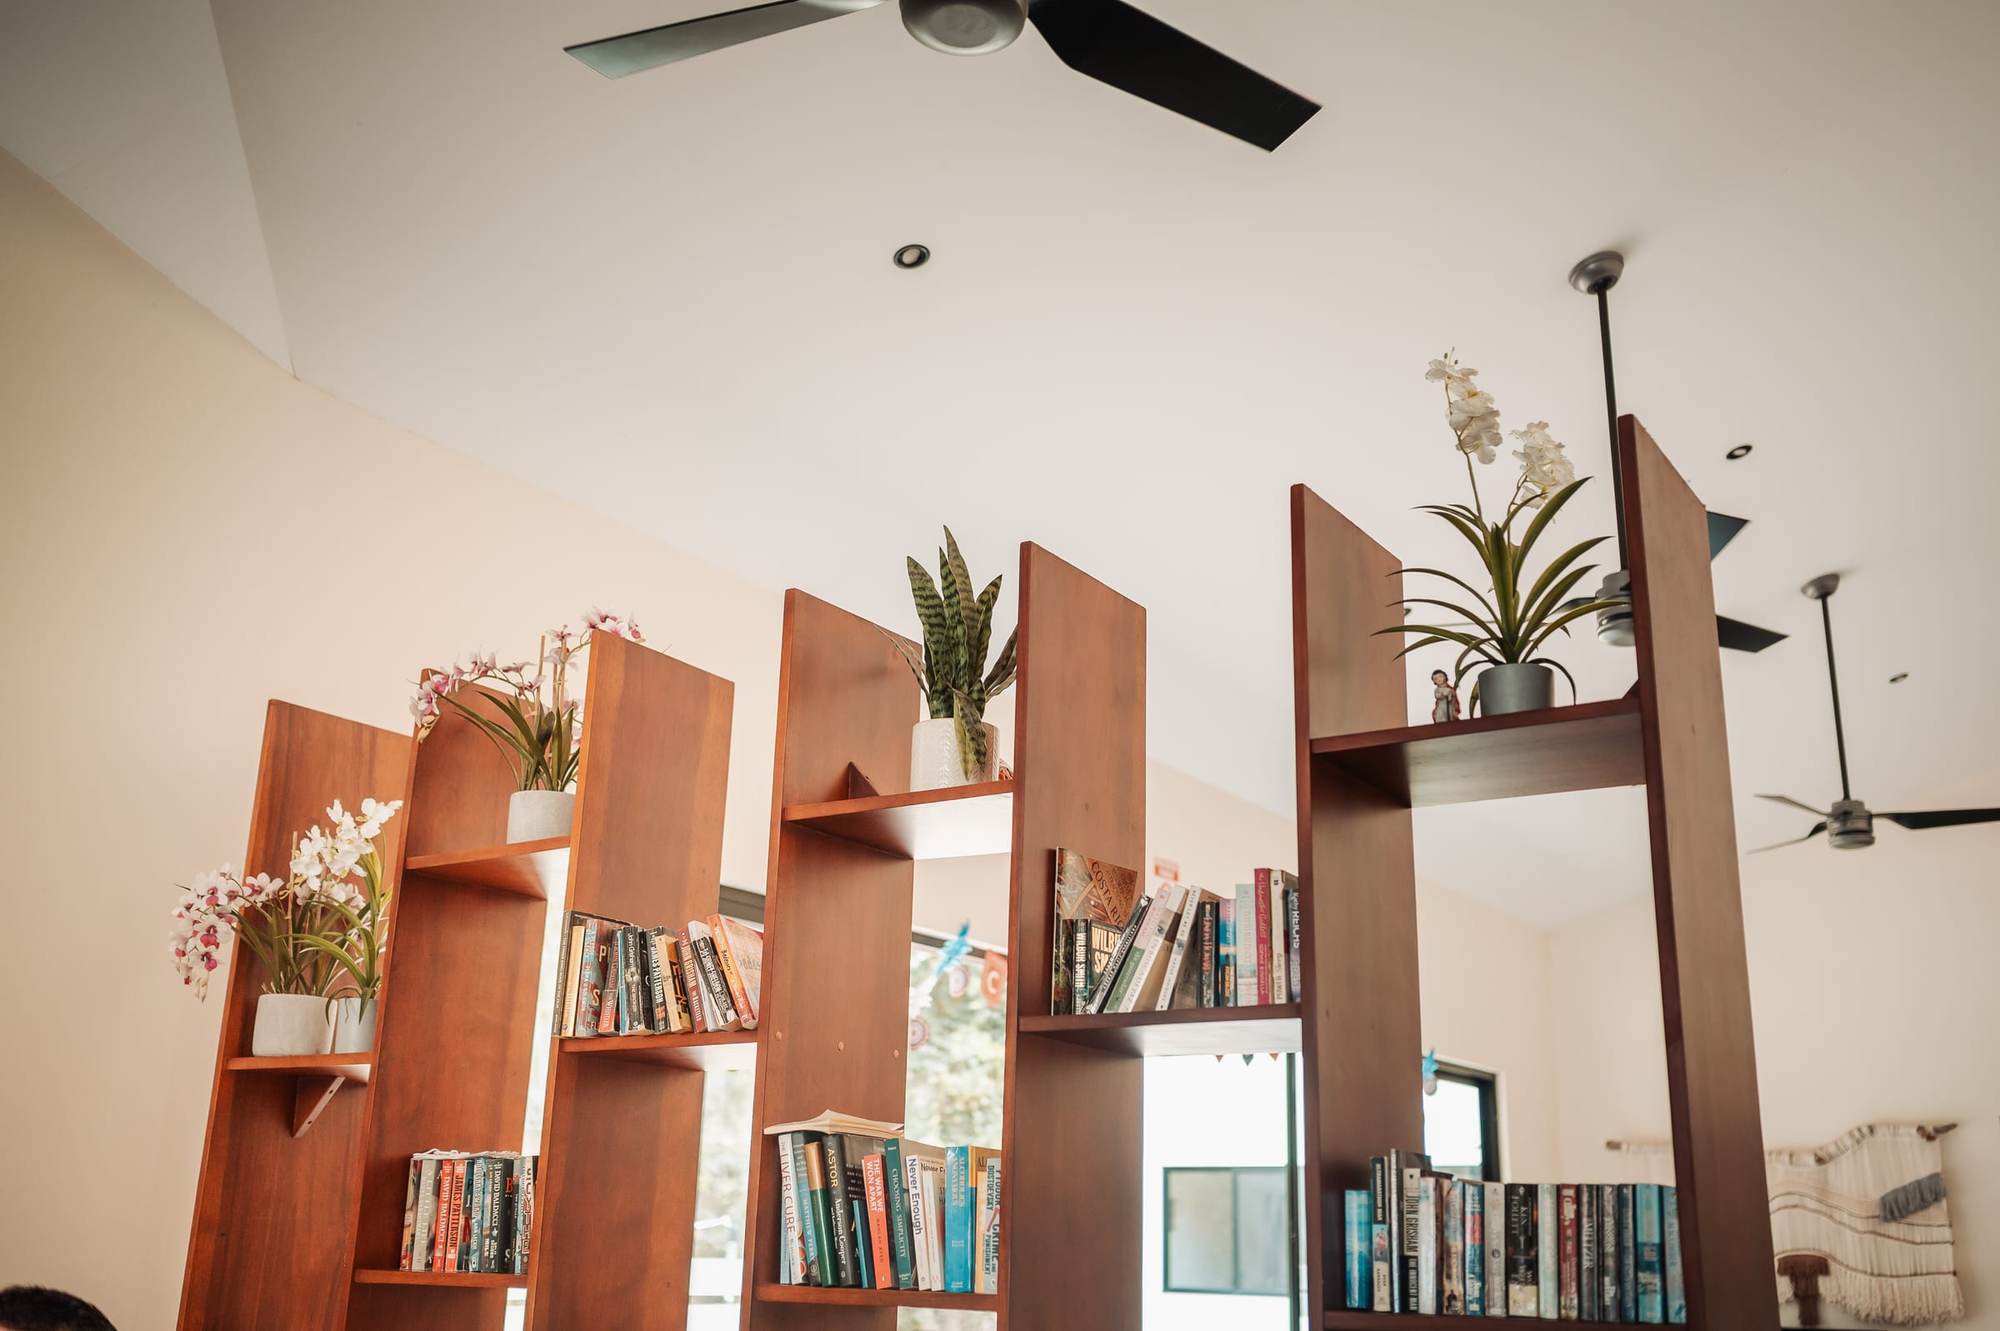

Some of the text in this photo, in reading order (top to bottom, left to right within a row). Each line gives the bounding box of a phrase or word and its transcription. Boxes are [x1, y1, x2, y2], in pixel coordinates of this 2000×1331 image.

[1091, 861, 1114, 906] COSTA
[1076, 932, 1086, 962] WILBUR
[1092, 926, 1121, 954] WILB
[652, 967, 664, 1004] PATTERSON
[1075, 964, 1086, 987] SMITH
[780, 1153, 791, 1192] LIVER
[827, 1148, 838, 1188] ASTOR
[866, 1161, 878, 1212] WON APART
[873, 1159, 881, 1176] THE
[877, 1199, 884, 1213] WE
[986, 1165, 994, 1211] DOSTOEVSKY
[449, 1176, 463, 1248] JAMES PATTERSON
[492, 1170, 501, 1227] DAVID BALDACCI
[783, 1193, 796, 1234] CURE
[891, 1168, 907, 1258] CHOOSING SIMPLICITY
[908, 1158, 923, 1235] Never Enough
[835, 1198, 849, 1265] Anderson Cooper
[991, 1223, 1000, 1262] CRIME
[1406, 1195, 1419, 1252] JOHN GRISHAM
